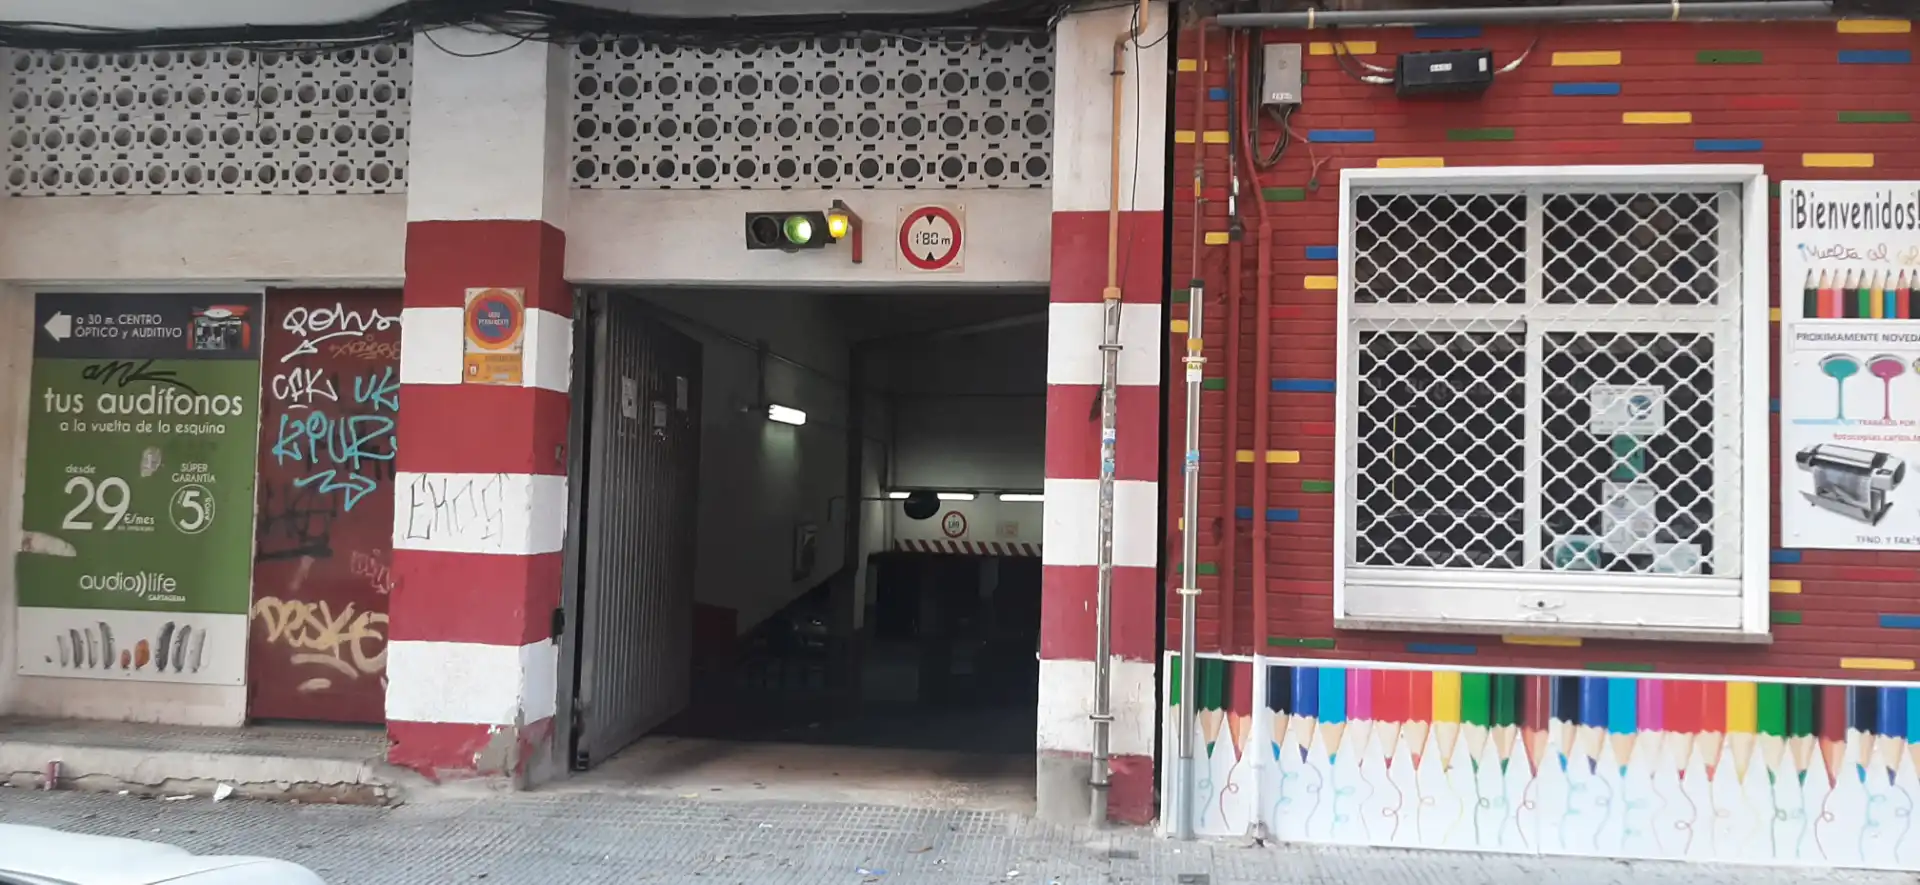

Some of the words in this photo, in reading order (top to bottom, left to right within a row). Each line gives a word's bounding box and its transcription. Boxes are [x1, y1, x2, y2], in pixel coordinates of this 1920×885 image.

[941, 237, 951, 245] m
[76, 317, 84, 325] a
[88, 314, 102, 325] 30
[118, 314, 162, 325] CENTRO
[75, 325, 118, 338] ÓPTICO
[122, 329, 129, 339] y
[131, 327, 183, 338] AUDITIVO
[44, 387, 84, 414] tus
[97, 385, 244, 416] audífonos
[59, 422, 69, 432] a
[74, 419, 86, 432] la
[92, 420, 131, 433] vuelta
[136, 420, 153, 433] de
[158, 419, 171, 433] la
[175, 422, 226, 436] esquina
[65, 464, 96, 474] desde
[181, 461, 208, 472] SÚPER
[171, 472, 216, 483] GARANTÍA
[62, 476, 131, 531] 29
[180, 490, 204, 530] 5
